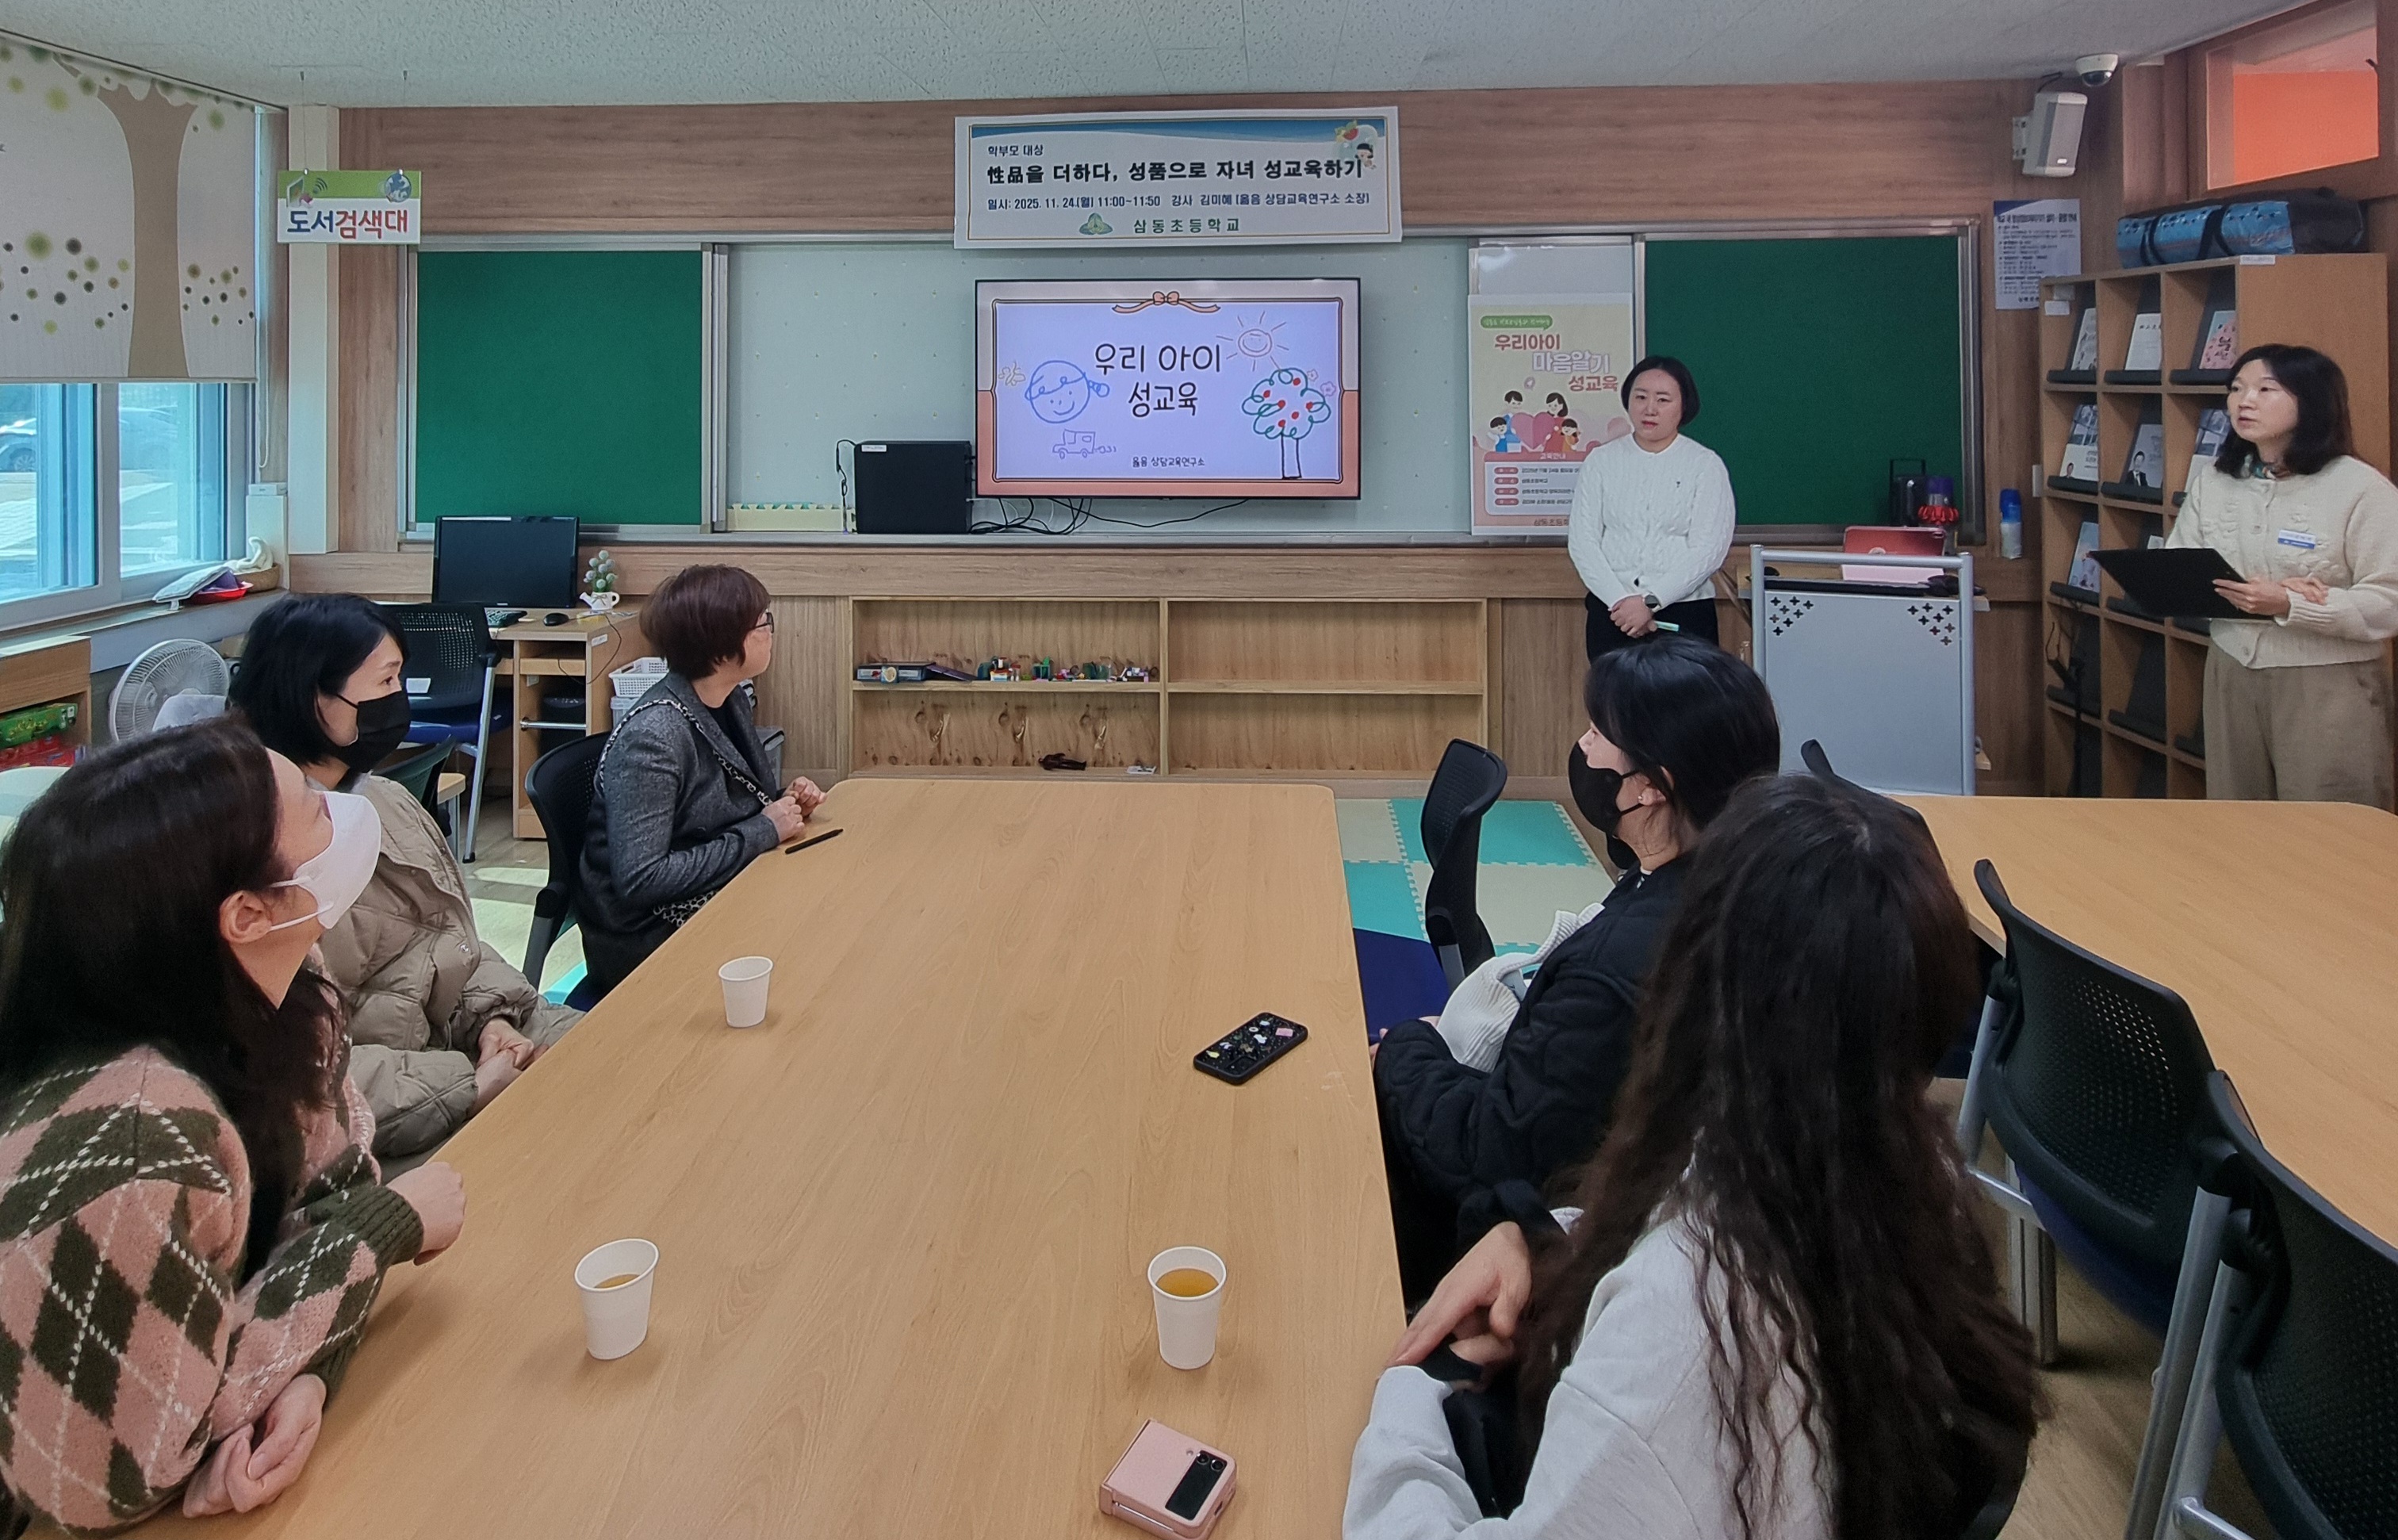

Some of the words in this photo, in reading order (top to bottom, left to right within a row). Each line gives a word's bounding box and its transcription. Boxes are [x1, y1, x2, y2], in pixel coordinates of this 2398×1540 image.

[988, 145, 1019, 157] 학부모
[1023, 144, 1044, 156] 대상
[987, 165, 1044, 184] 性品을
[1053, 163, 1117, 183] 더하다,
[1128, 161, 1207, 182] 성품으로
[1216, 160, 1254, 179] 자녀
[1264, 159, 1362, 178] 성교육하기
[988, 198, 1012, 210] 일시:
[1014, 198, 1041, 209] 2025.
[1045, 197, 1059, 209] 11.
[1171, 195, 1193, 207] 강사
[1266, 193, 1340, 205] 상담교육연구소
[287, 209, 408, 239] 도서검색대
[1133, 218, 1239, 234] 삼동초등학교
[1495, 334, 1561, 351] 우리아이
[1094, 343, 1146, 376] 우리
[1159, 343, 1221, 374] 아이
[1532, 351, 1610, 374] 마음알기
[1569, 375, 1618, 393] 성교육
[1128, 381, 1199, 418] 성교육
[1151, 456, 1205, 468] 상담교육연구소
